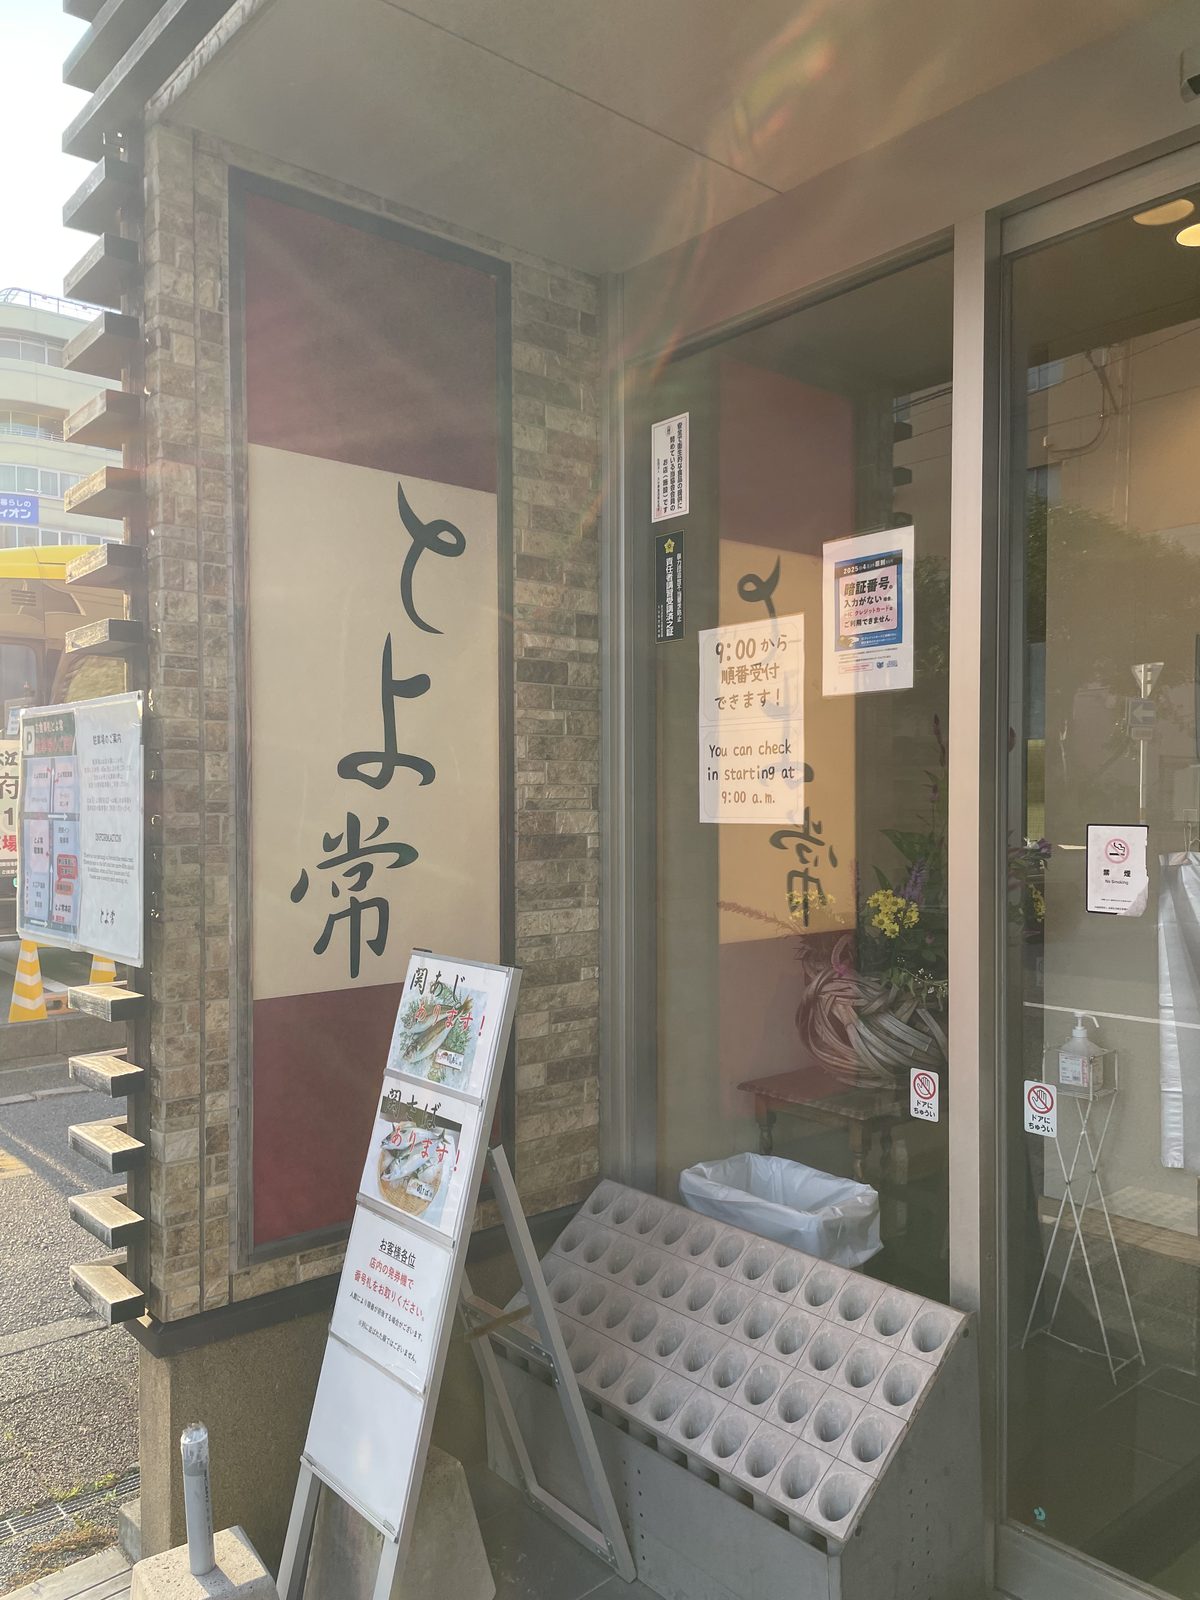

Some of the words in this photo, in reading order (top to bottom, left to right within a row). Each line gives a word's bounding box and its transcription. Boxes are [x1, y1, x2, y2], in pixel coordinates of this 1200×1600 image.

[721, 662, 780, 684] 順番受付
[290, 480, 466, 979] とよ常
[709, 744, 728, 758] You
[733, 745, 753, 757] can
[758, 739, 792, 756] check
[707, 767, 719, 781] in
[724, 765, 776, 781] starting
[781, 766, 795, 780] at
[721, 791, 747, 805] 9:00
[752, 791, 776, 804] a.m.
[410, 967, 466, 1003] 関あじ
[913, 1107, 936, 1118] ちゅうい
[916, 1100, 933, 1110] ドアに
[1028, 1121, 1054, 1133] ちゅうい
[1031, 1114, 1051, 1125] ドアに
[380, 1238, 417, 1267] お客様各位
[369, 1257, 415, 1290] 店内の発券機で
[353, 1269, 425, 1322] 番号札をお取りください。
